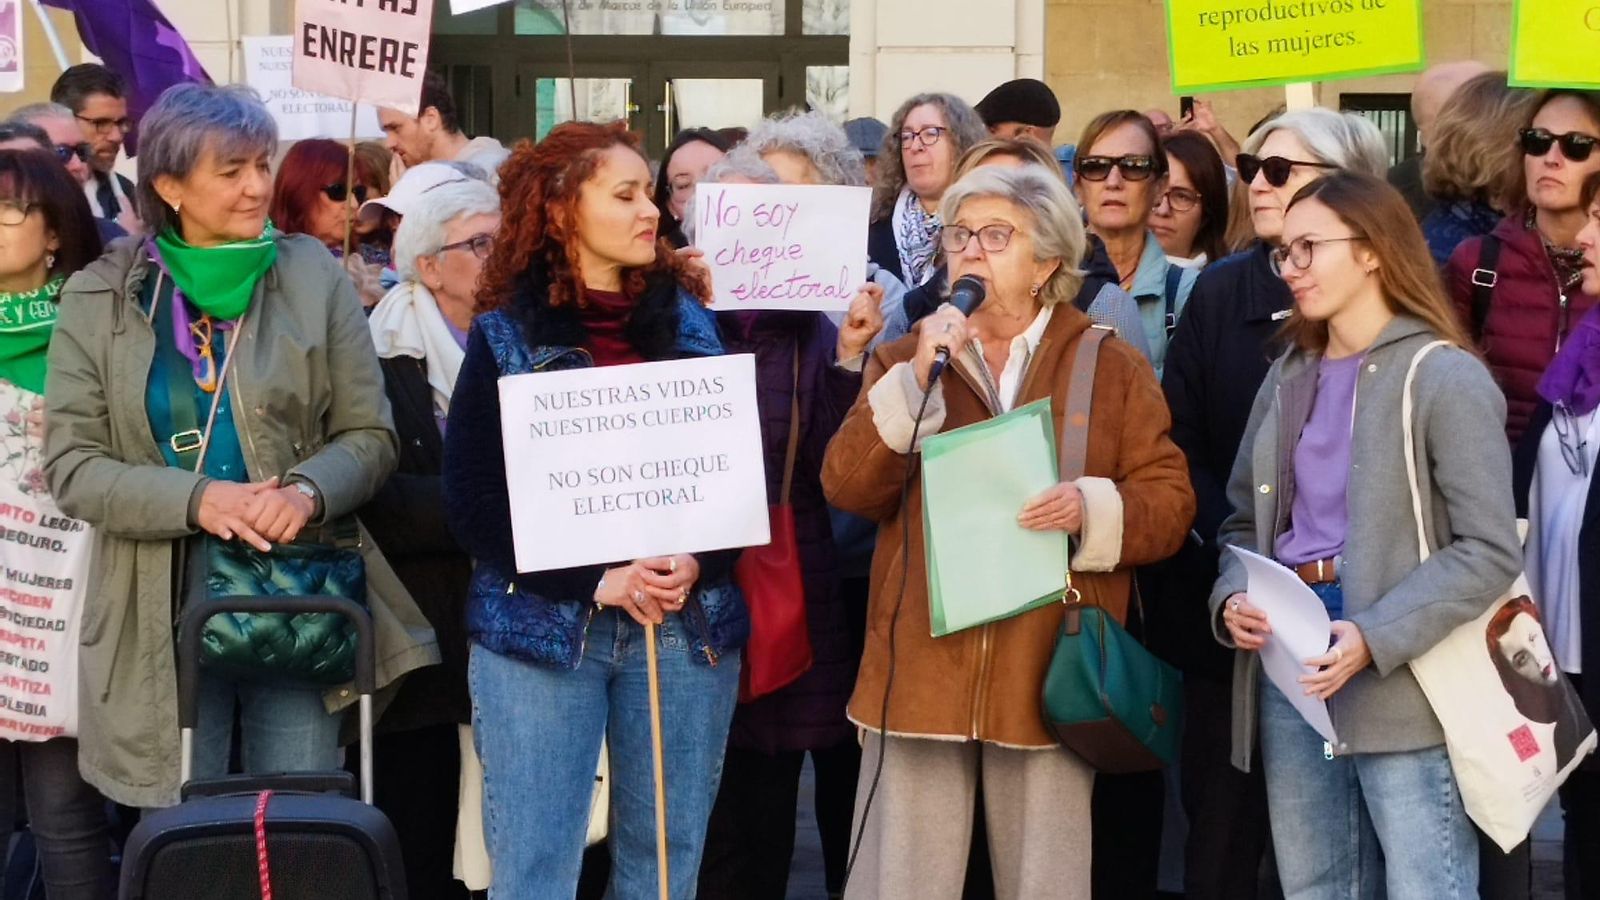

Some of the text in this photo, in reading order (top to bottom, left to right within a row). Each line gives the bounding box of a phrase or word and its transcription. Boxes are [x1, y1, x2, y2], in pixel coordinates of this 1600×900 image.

[1198, 0, 1360, 30] reproductivos
[261, 47, 293, 57] NUES
[302, 22, 419, 79] ENRERE
[1229, 29, 1362, 58] las mujeres.
[281, 102, 352, 115] ELECTORAL
[704, 189, 741, 228] No
[714, 240, 804, 279] cheque
[730, 265, 852, 300] electoral
[532, 376, 725, 413] NUESTRAS VIDAS
[529, 402, 734, 440] NUESTROS CUERPOS
[548, 453, 731, 491] NO SON CHEQUE
[572, 484, 706, 517] ELECTORAL
[6, 567, 74, 591] MUJERES
